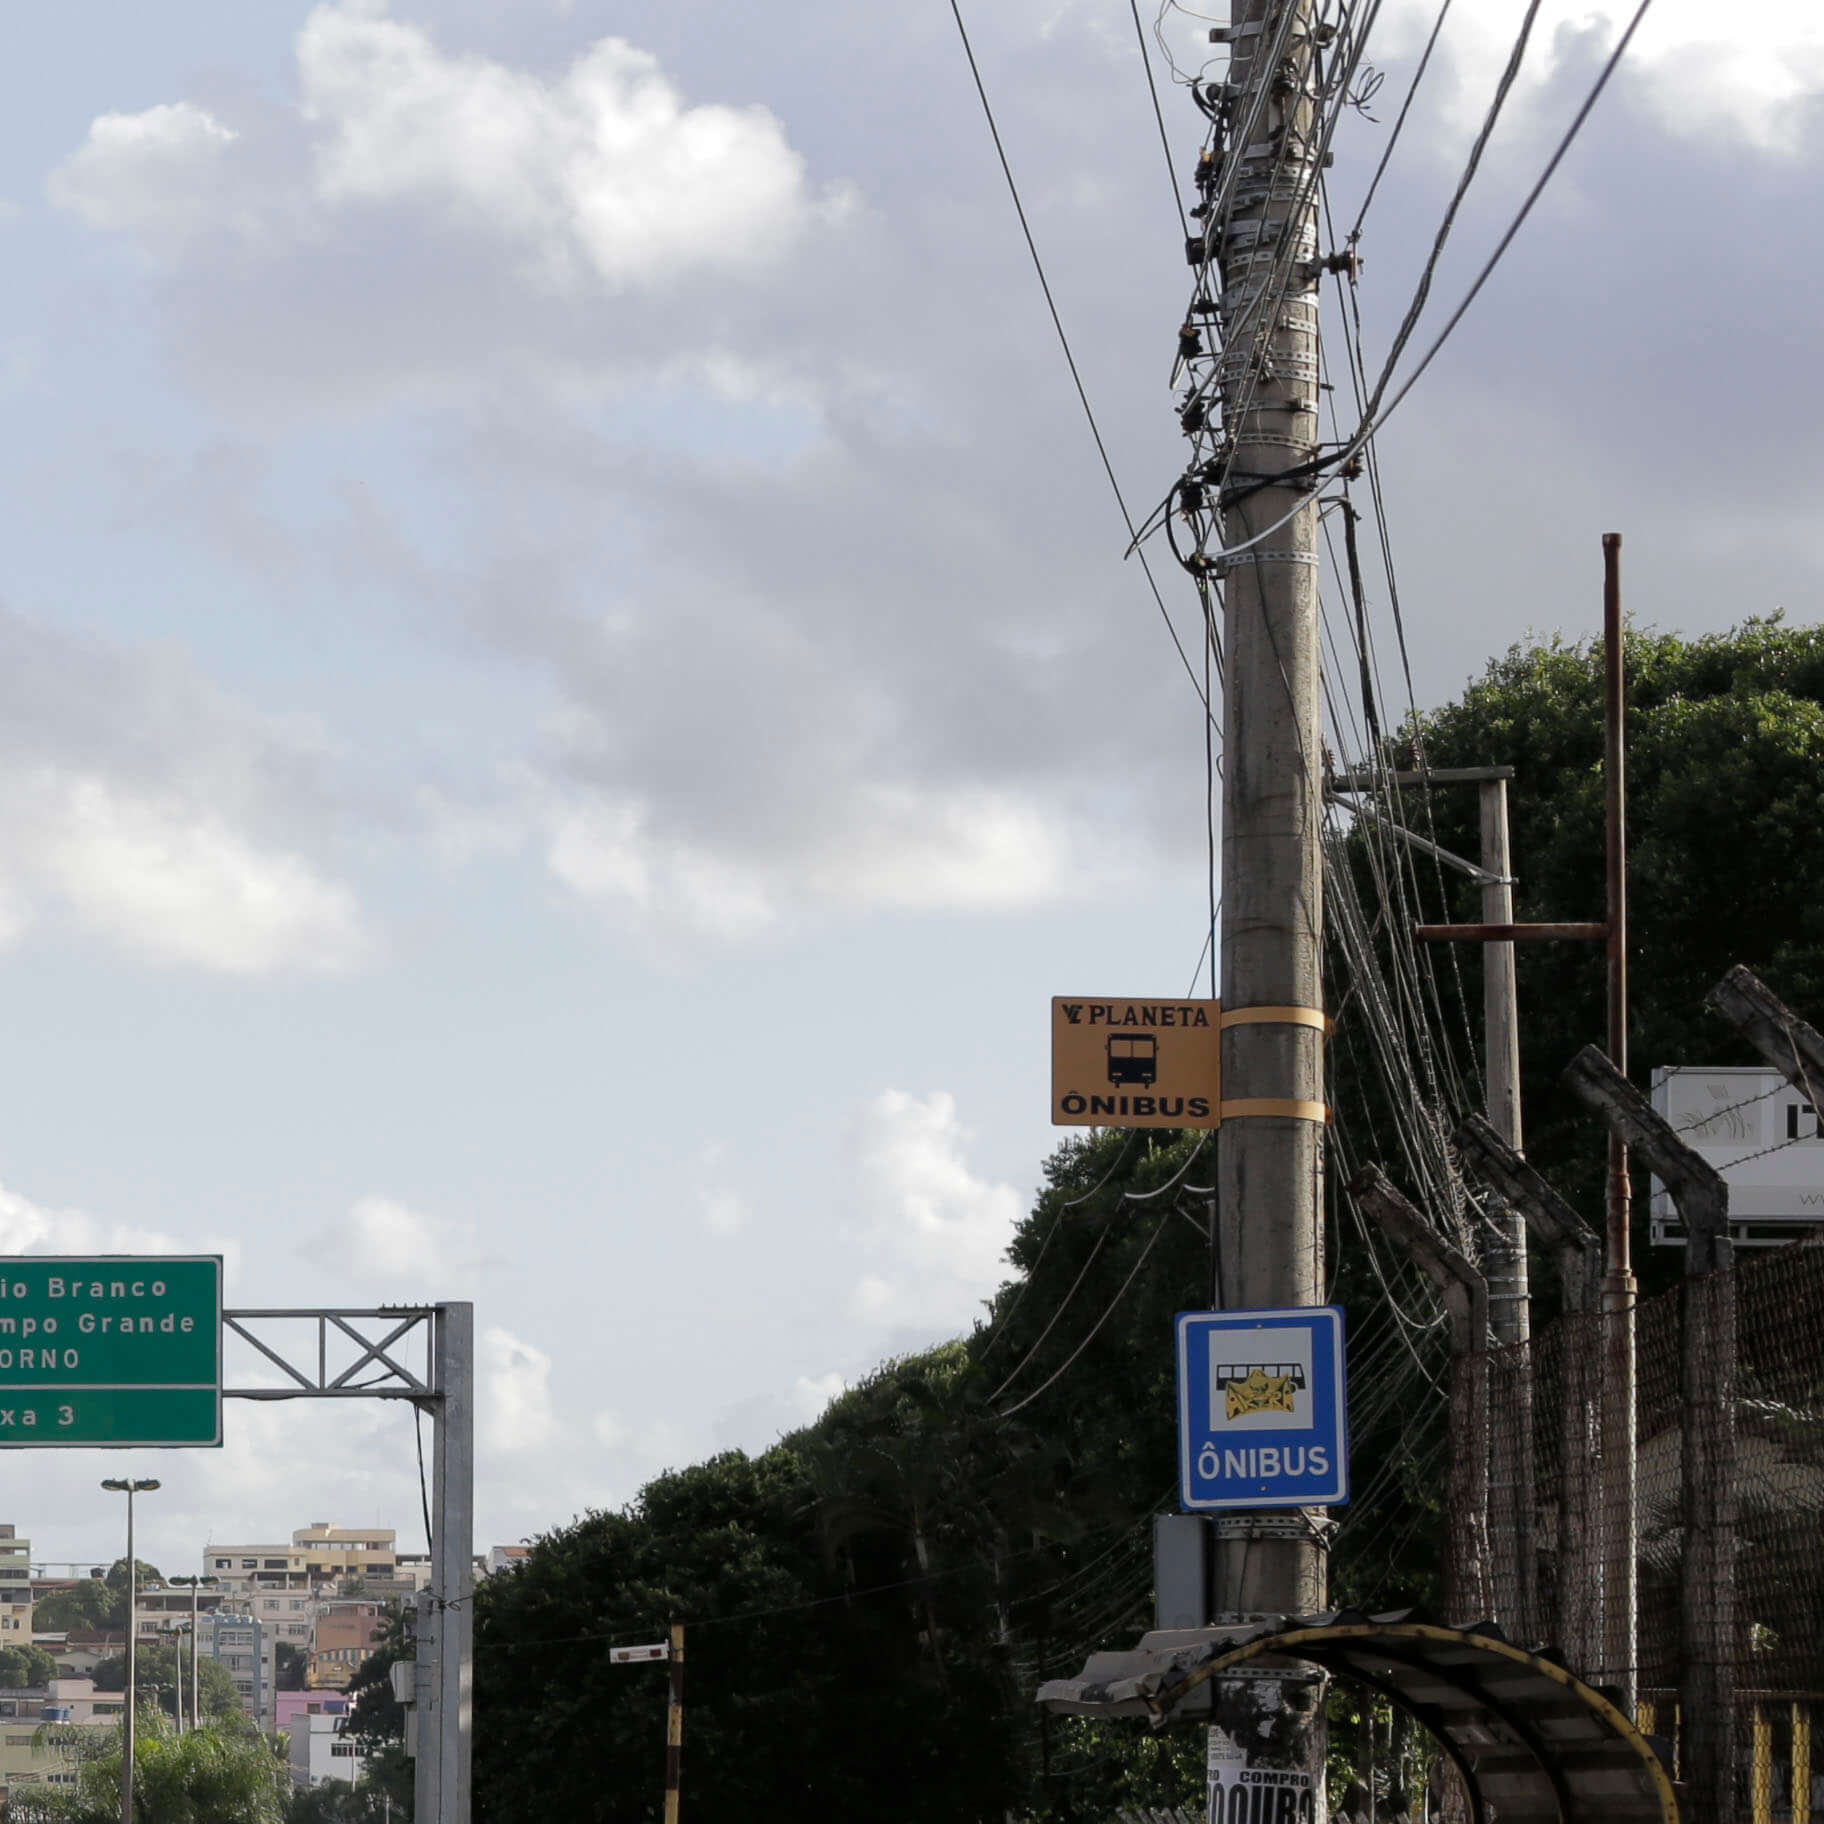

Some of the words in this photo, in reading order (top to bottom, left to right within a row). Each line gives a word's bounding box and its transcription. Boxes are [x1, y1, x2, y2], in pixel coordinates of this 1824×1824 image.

[1089, 1004, 1210, 1027] PLANETA
[1061, 1090, 1211, 1118] ÔNIBUS
[47, 1277, 168, 1299] Branco
[78, 1311, 196, 1334] Grande
[57, 1404, 76, 1427] 3
[1197, 1440, 1330, 1480] ÔNIBUS
[1239, 1770, 1309, 1788] COMPRO
